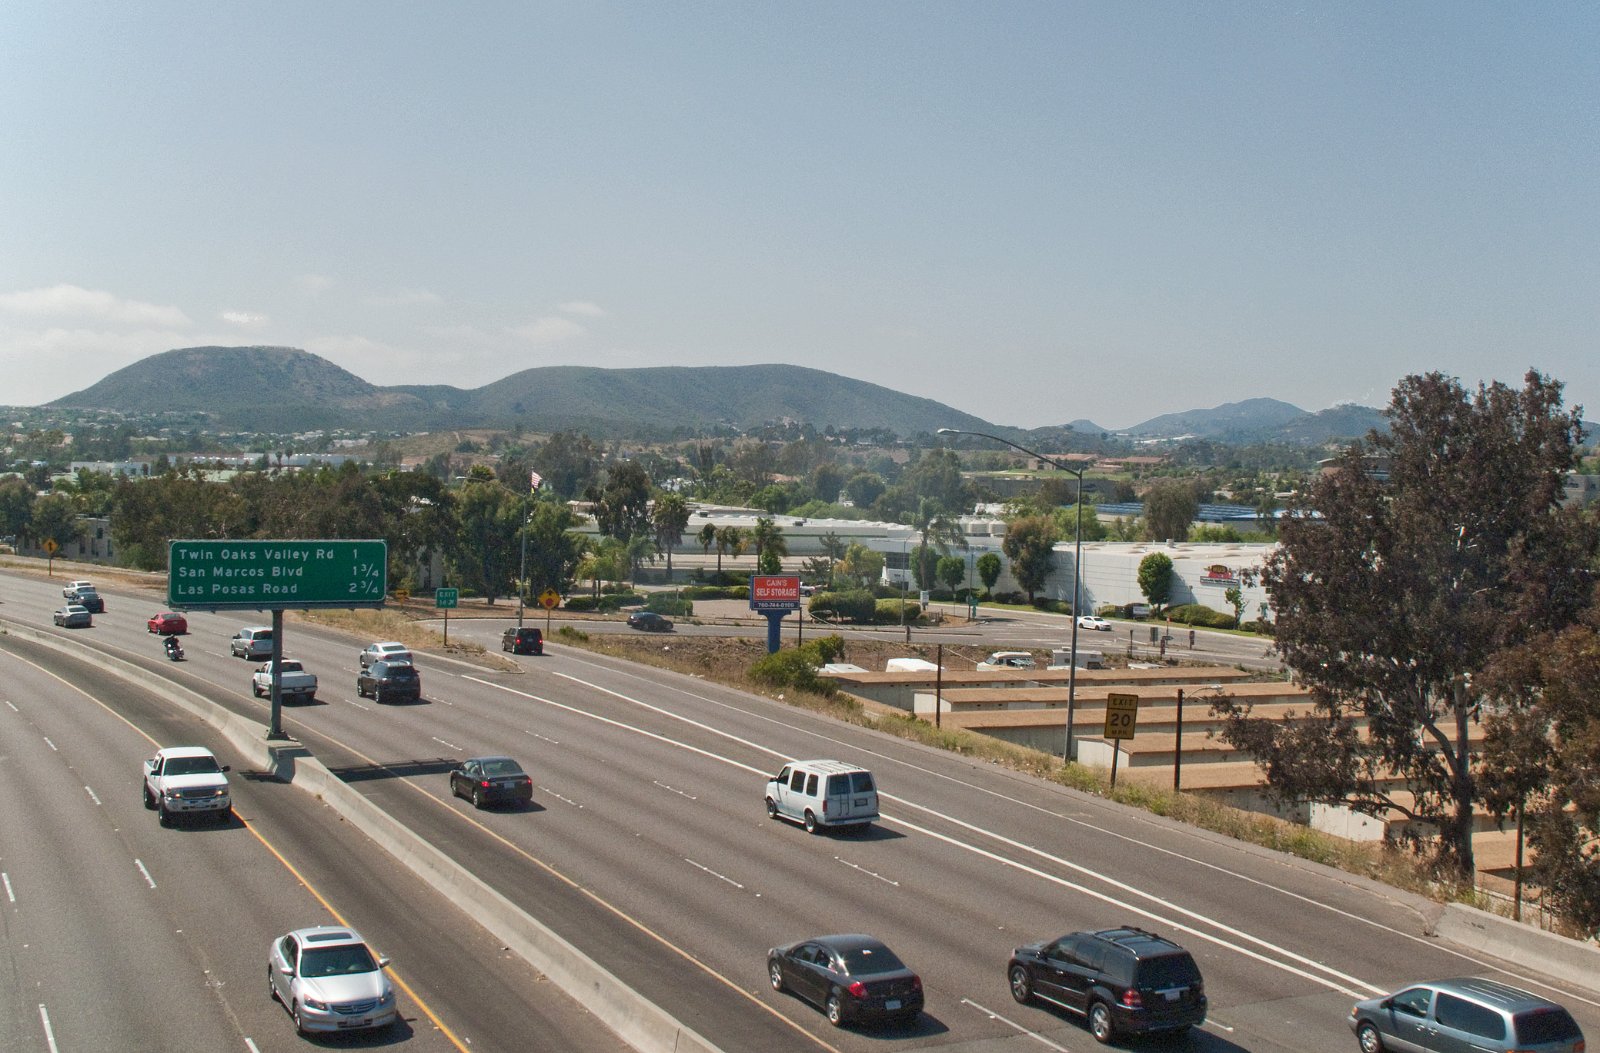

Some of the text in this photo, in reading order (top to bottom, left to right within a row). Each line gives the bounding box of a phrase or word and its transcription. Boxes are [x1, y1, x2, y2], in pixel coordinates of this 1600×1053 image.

[178, 549, 358, 561] Twin Oaks Valley Rd 1
[178, 566, 206, 577] San
[212, 566, 265, 577] Marcos
[272, 566, 303, 577] Blvd
[352, 566, 358, 576] 1
[178, 584, 204, 595] Las
[211, 584, 256, 594] Posas
[262, 583, 298, 593] Road
[348, 583, 358, 593] 2
[756, 588, 797, 597] SELF STORAGE
[1110, 713, 1130, 727] 20
